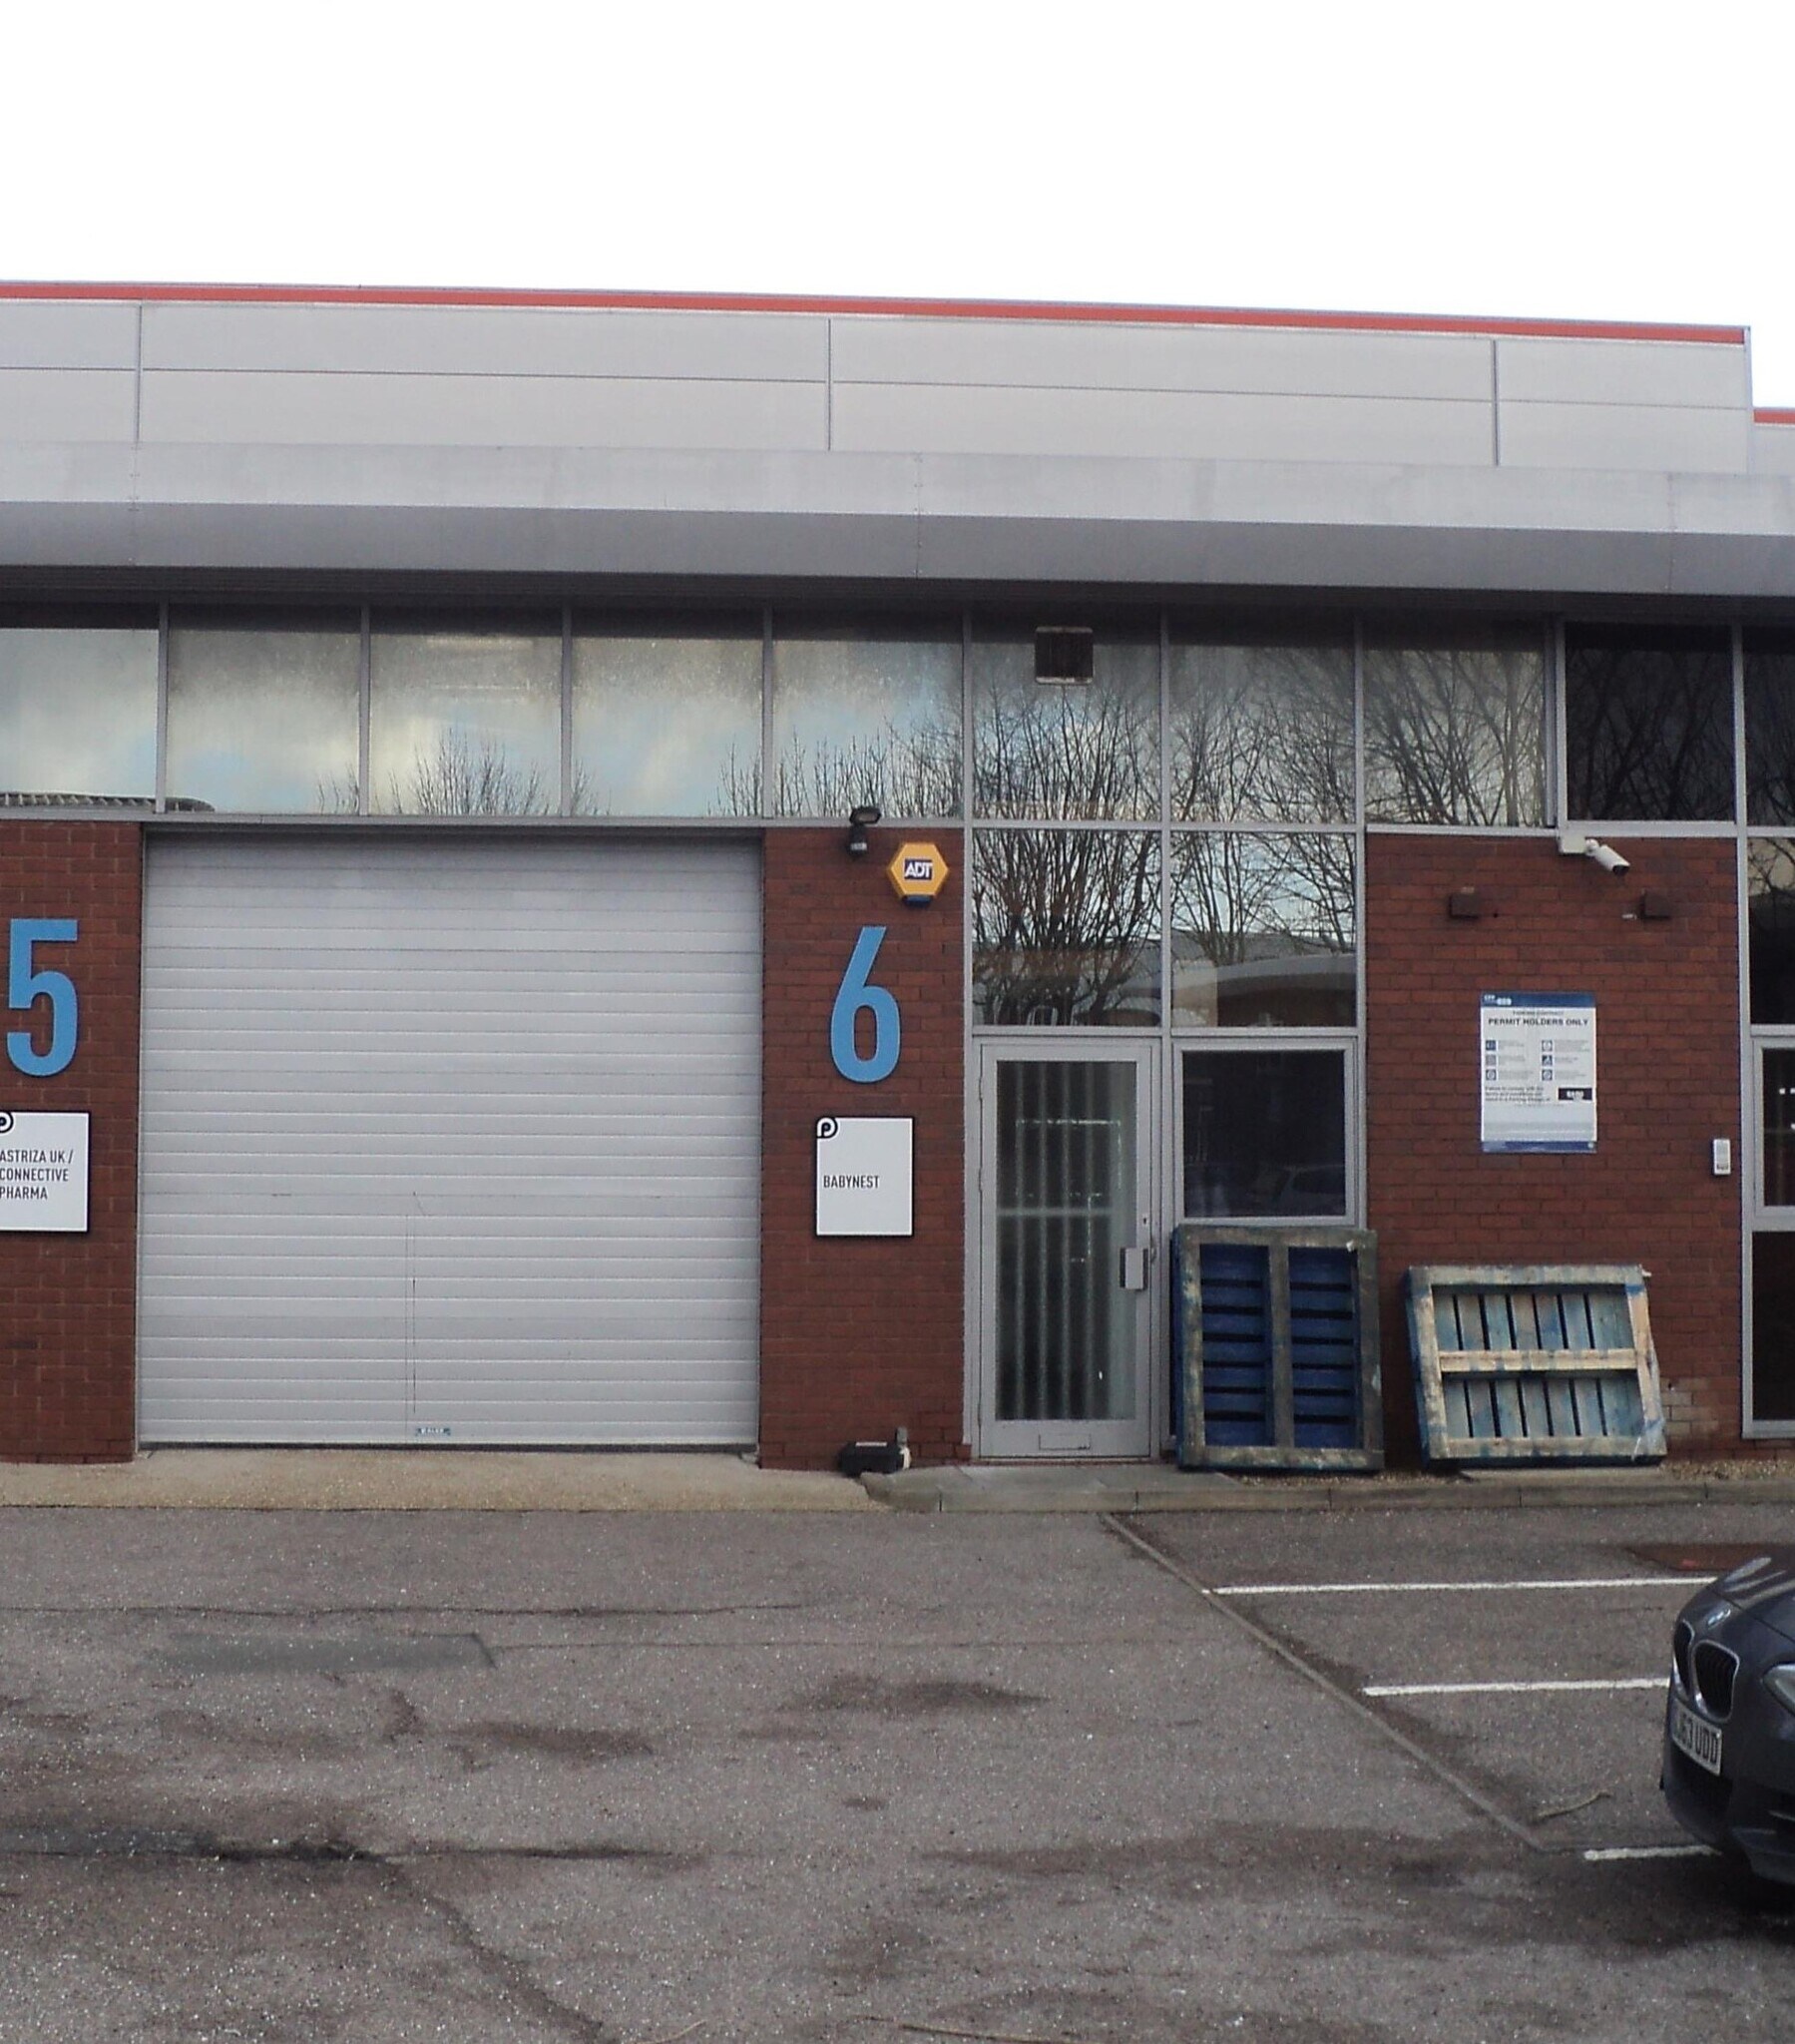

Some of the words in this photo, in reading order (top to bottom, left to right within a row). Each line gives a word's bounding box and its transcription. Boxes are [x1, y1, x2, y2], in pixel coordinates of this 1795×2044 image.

[905, 861, 933, 877] ADT
[7, 918, 78, 1076] 5
[830, 926, 901, 1083] 6
[0, 1150, 47, 1163] ASTRIZA
[50, 1150, 65, 1163] UK
[68, 1149, 73, 1164] /
[0, 1168, 69, 1182] CONNECTIVE
[823, 1176, 879, 1189] BABYNEST
[0, 1186, 48, 1200] PHARMA
